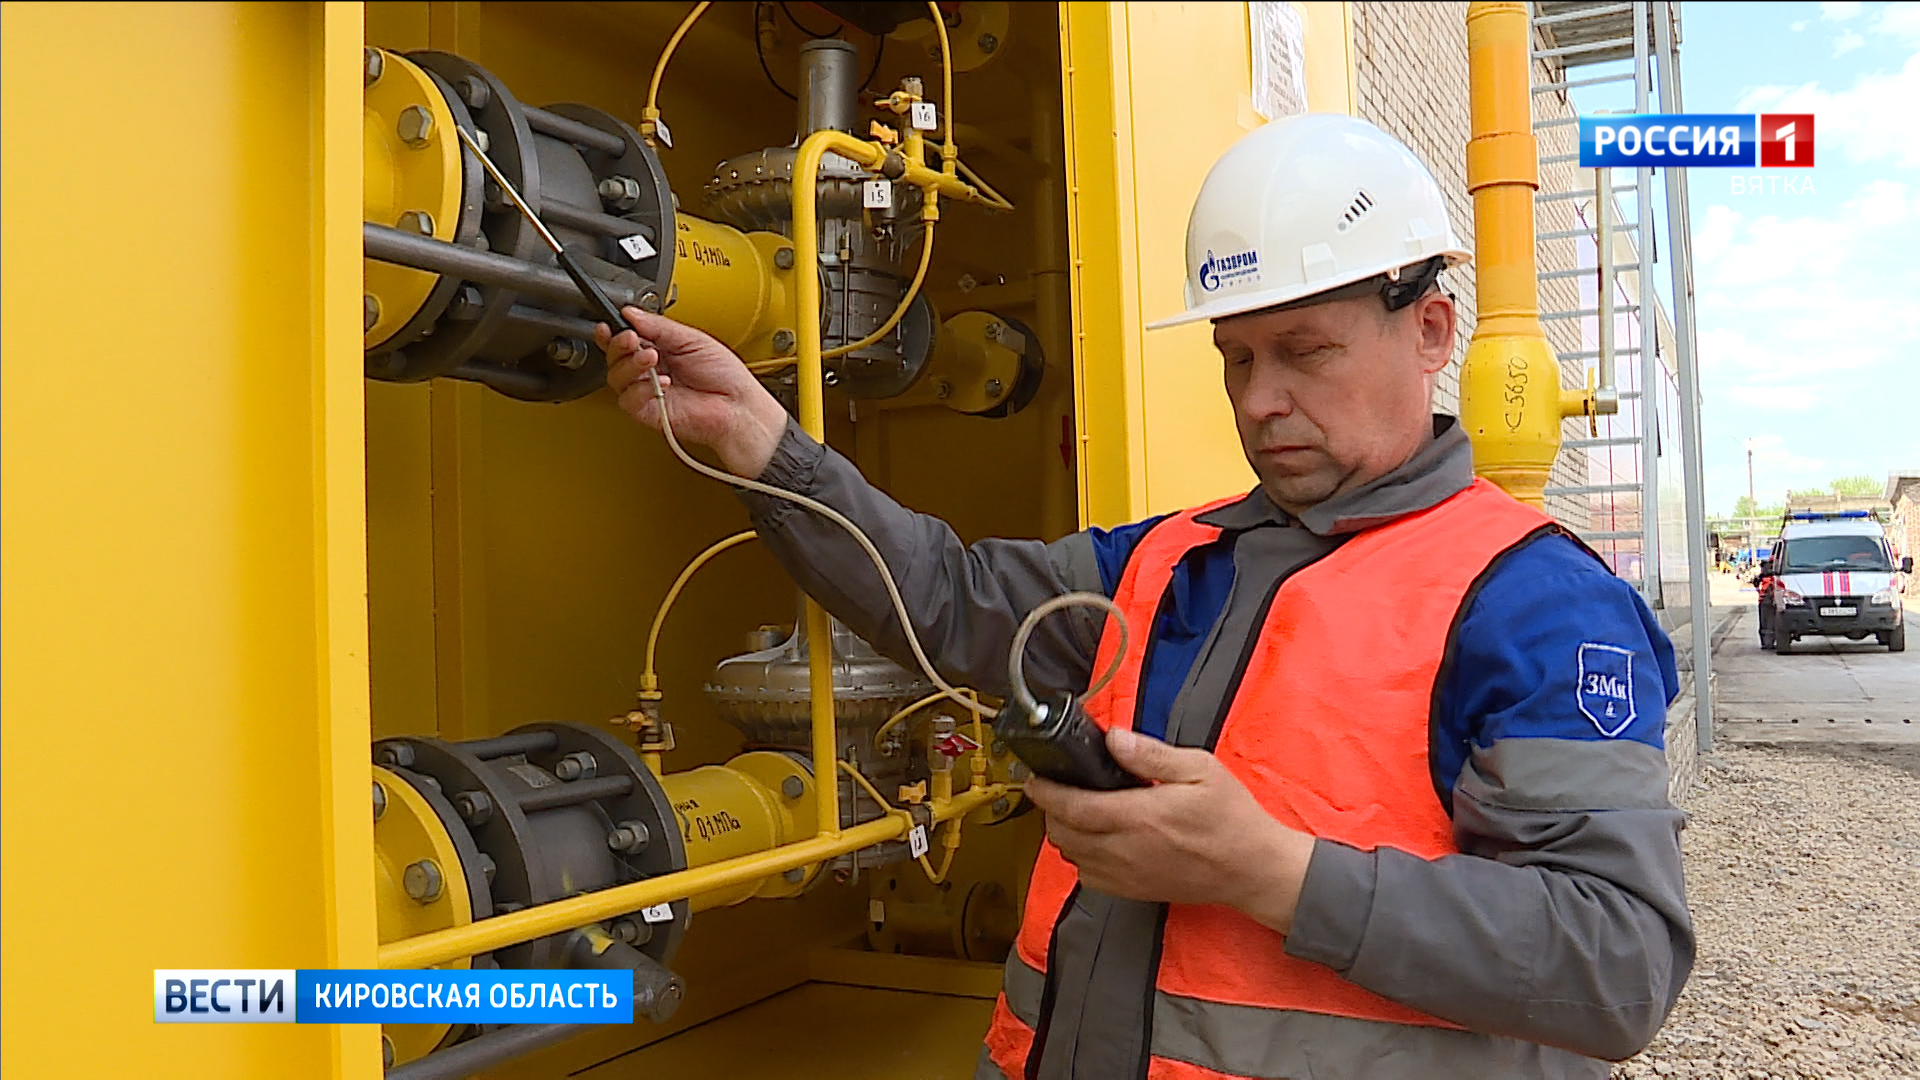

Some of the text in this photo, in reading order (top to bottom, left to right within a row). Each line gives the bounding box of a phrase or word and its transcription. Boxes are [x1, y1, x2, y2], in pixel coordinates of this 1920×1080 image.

[918, 111, 930, 122] 16
[871, 189, 885, 203] 15
[1216, 250, 1258, 273] ГАЗПРОМ
